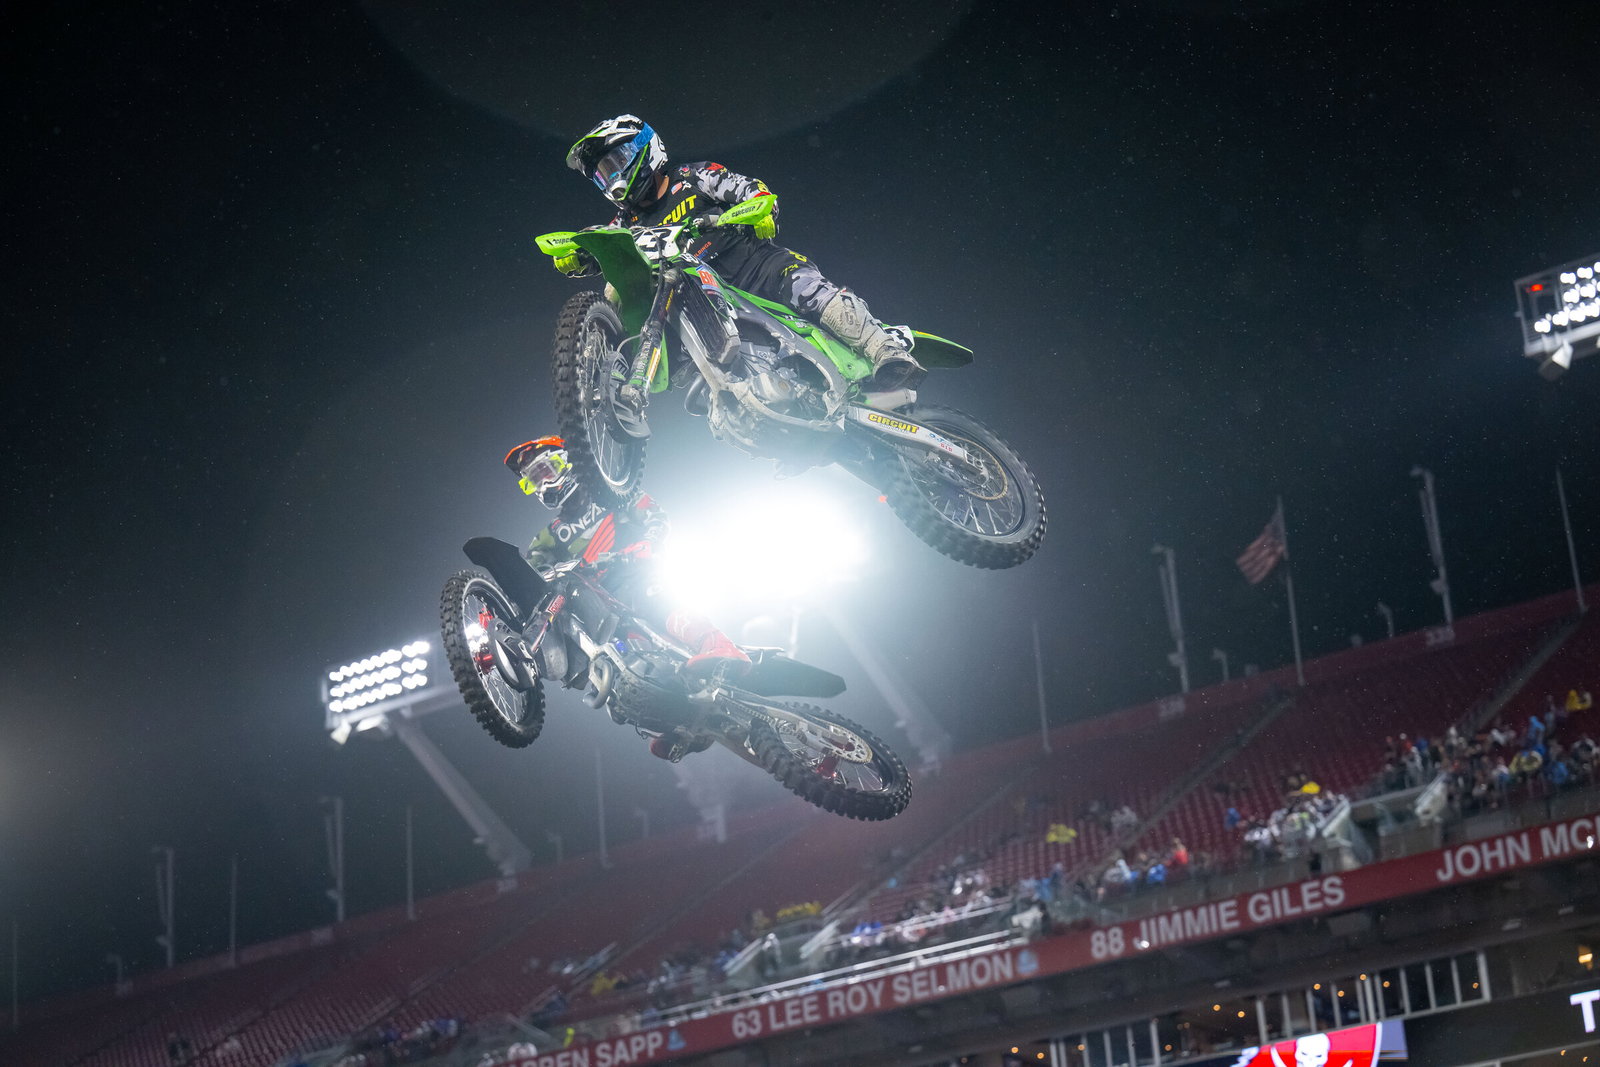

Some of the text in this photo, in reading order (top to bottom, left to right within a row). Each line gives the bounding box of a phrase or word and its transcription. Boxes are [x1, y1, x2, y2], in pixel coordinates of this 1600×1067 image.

[657, 194, 697, 226] CUIT
[868, 413, 919, 434] CIRCUIT
[1436, 815, 1600, 882] JOHN MC
[1090, 876, 1345, 959] 88 JIMMIE GILES
[732, 951, 1014, 1039] 63 LEE ROY SELMON
[595, 1031, 663, 1067] SAPP
